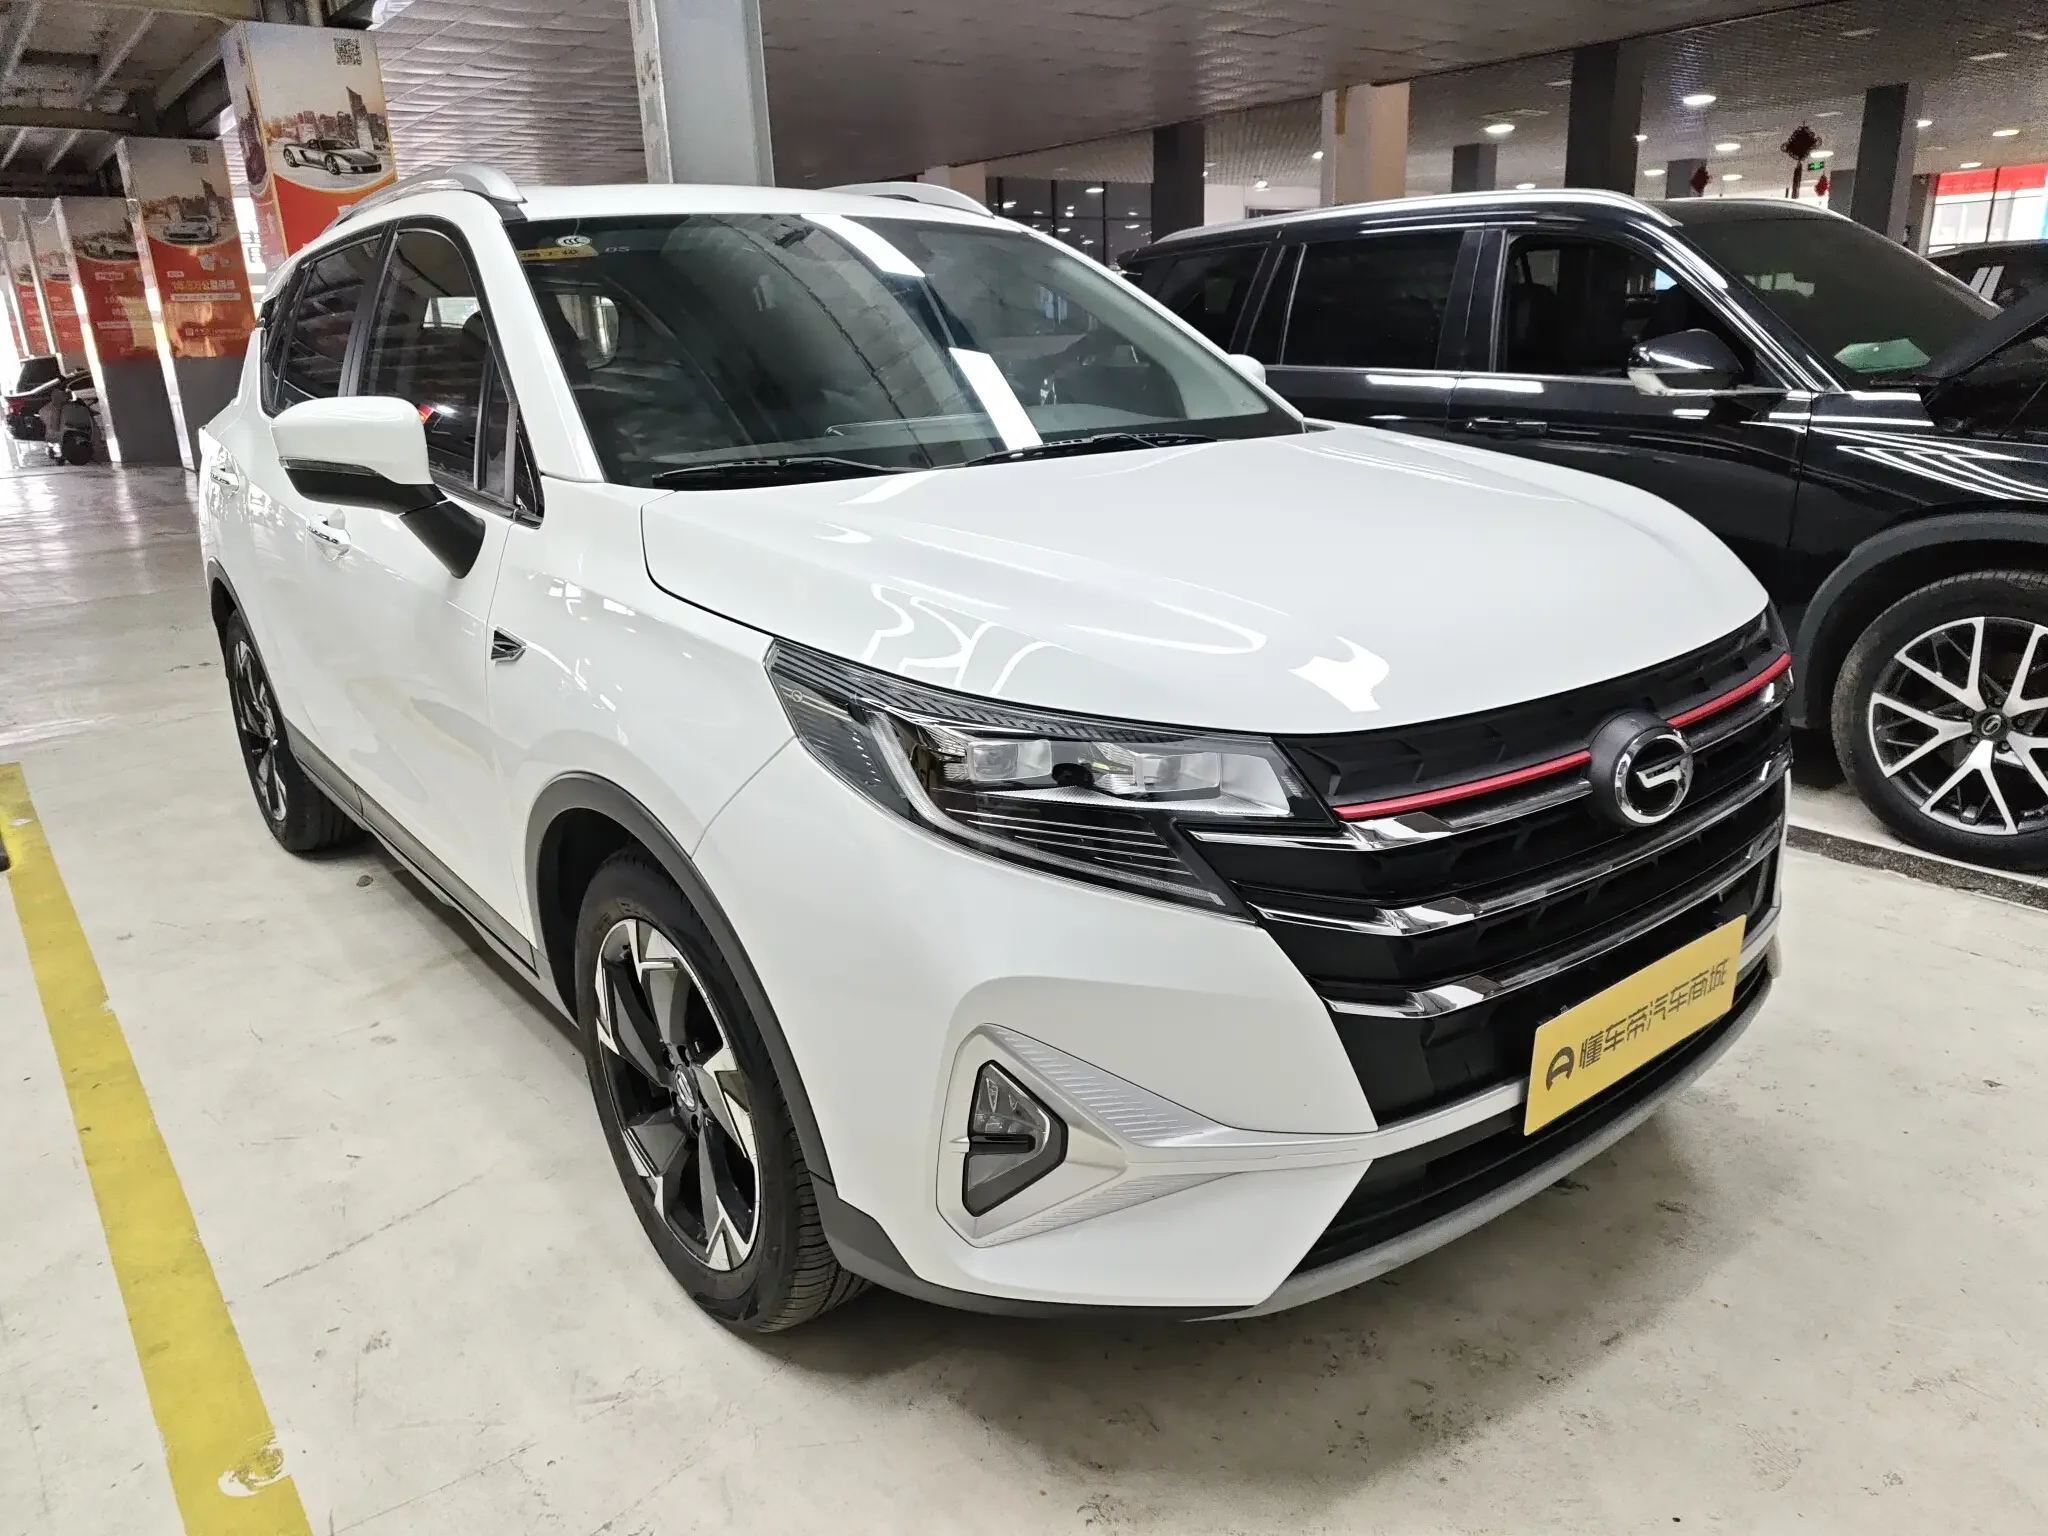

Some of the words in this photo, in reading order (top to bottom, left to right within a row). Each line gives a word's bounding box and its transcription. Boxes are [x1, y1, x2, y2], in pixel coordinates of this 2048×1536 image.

[1578, 957, 1731, 1069] 懂车帝汽车商城
